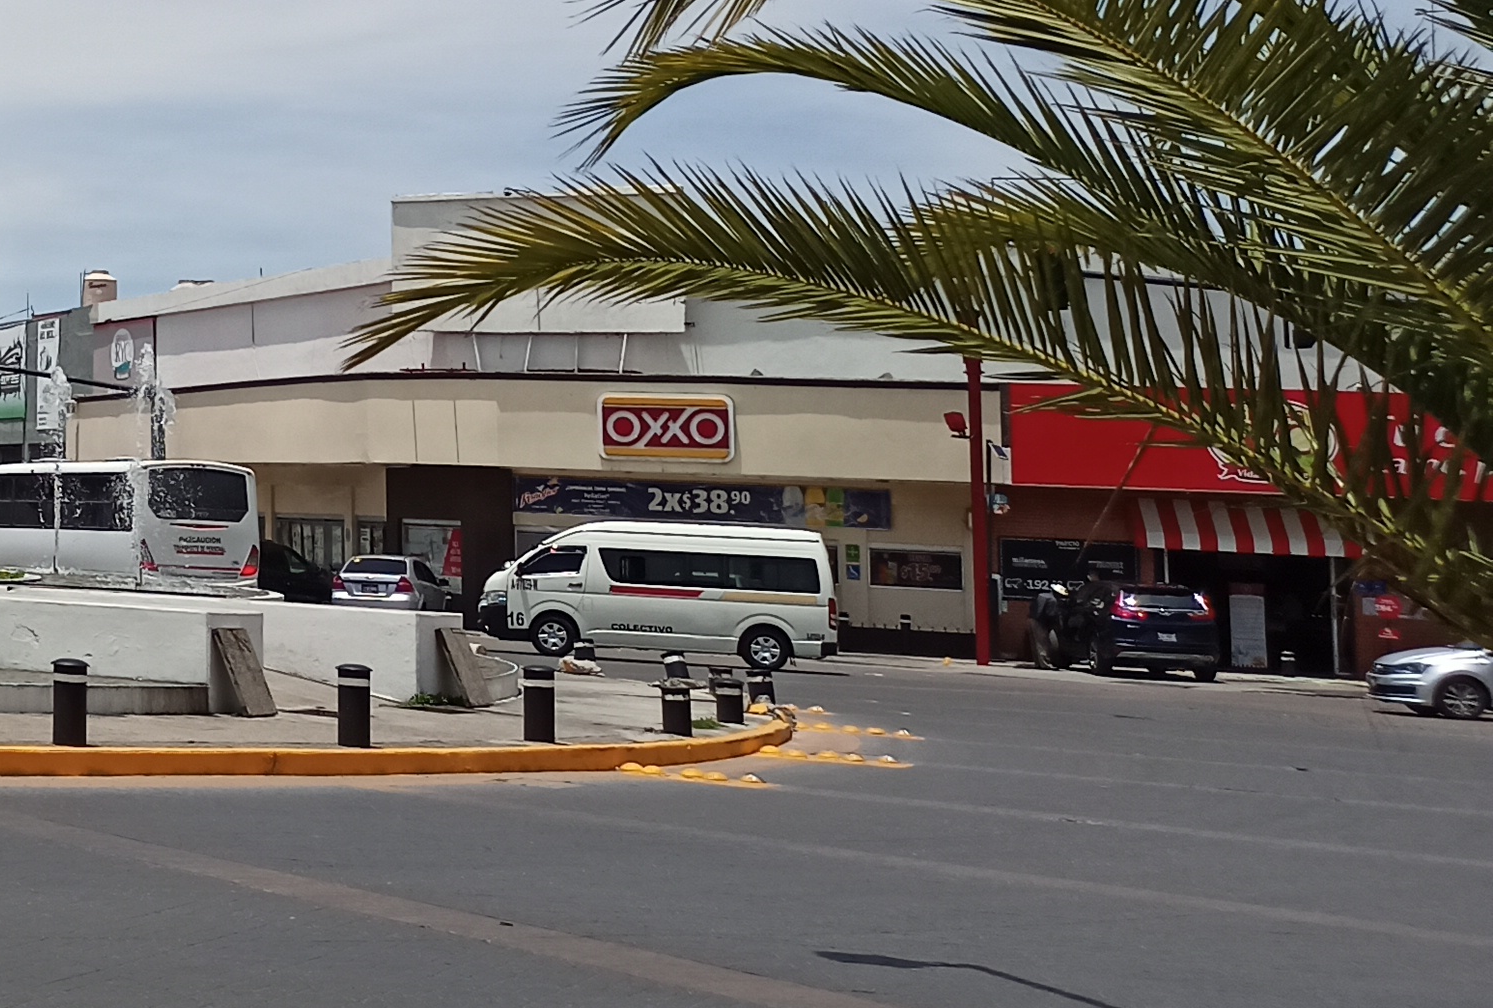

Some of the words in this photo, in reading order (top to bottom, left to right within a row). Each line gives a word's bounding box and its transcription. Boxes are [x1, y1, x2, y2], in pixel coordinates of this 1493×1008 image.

[605, 408, 726, 448] OXXO
[507, 611, 525, 627] 16
[610, 623, 673, 633] COLECTIVO
